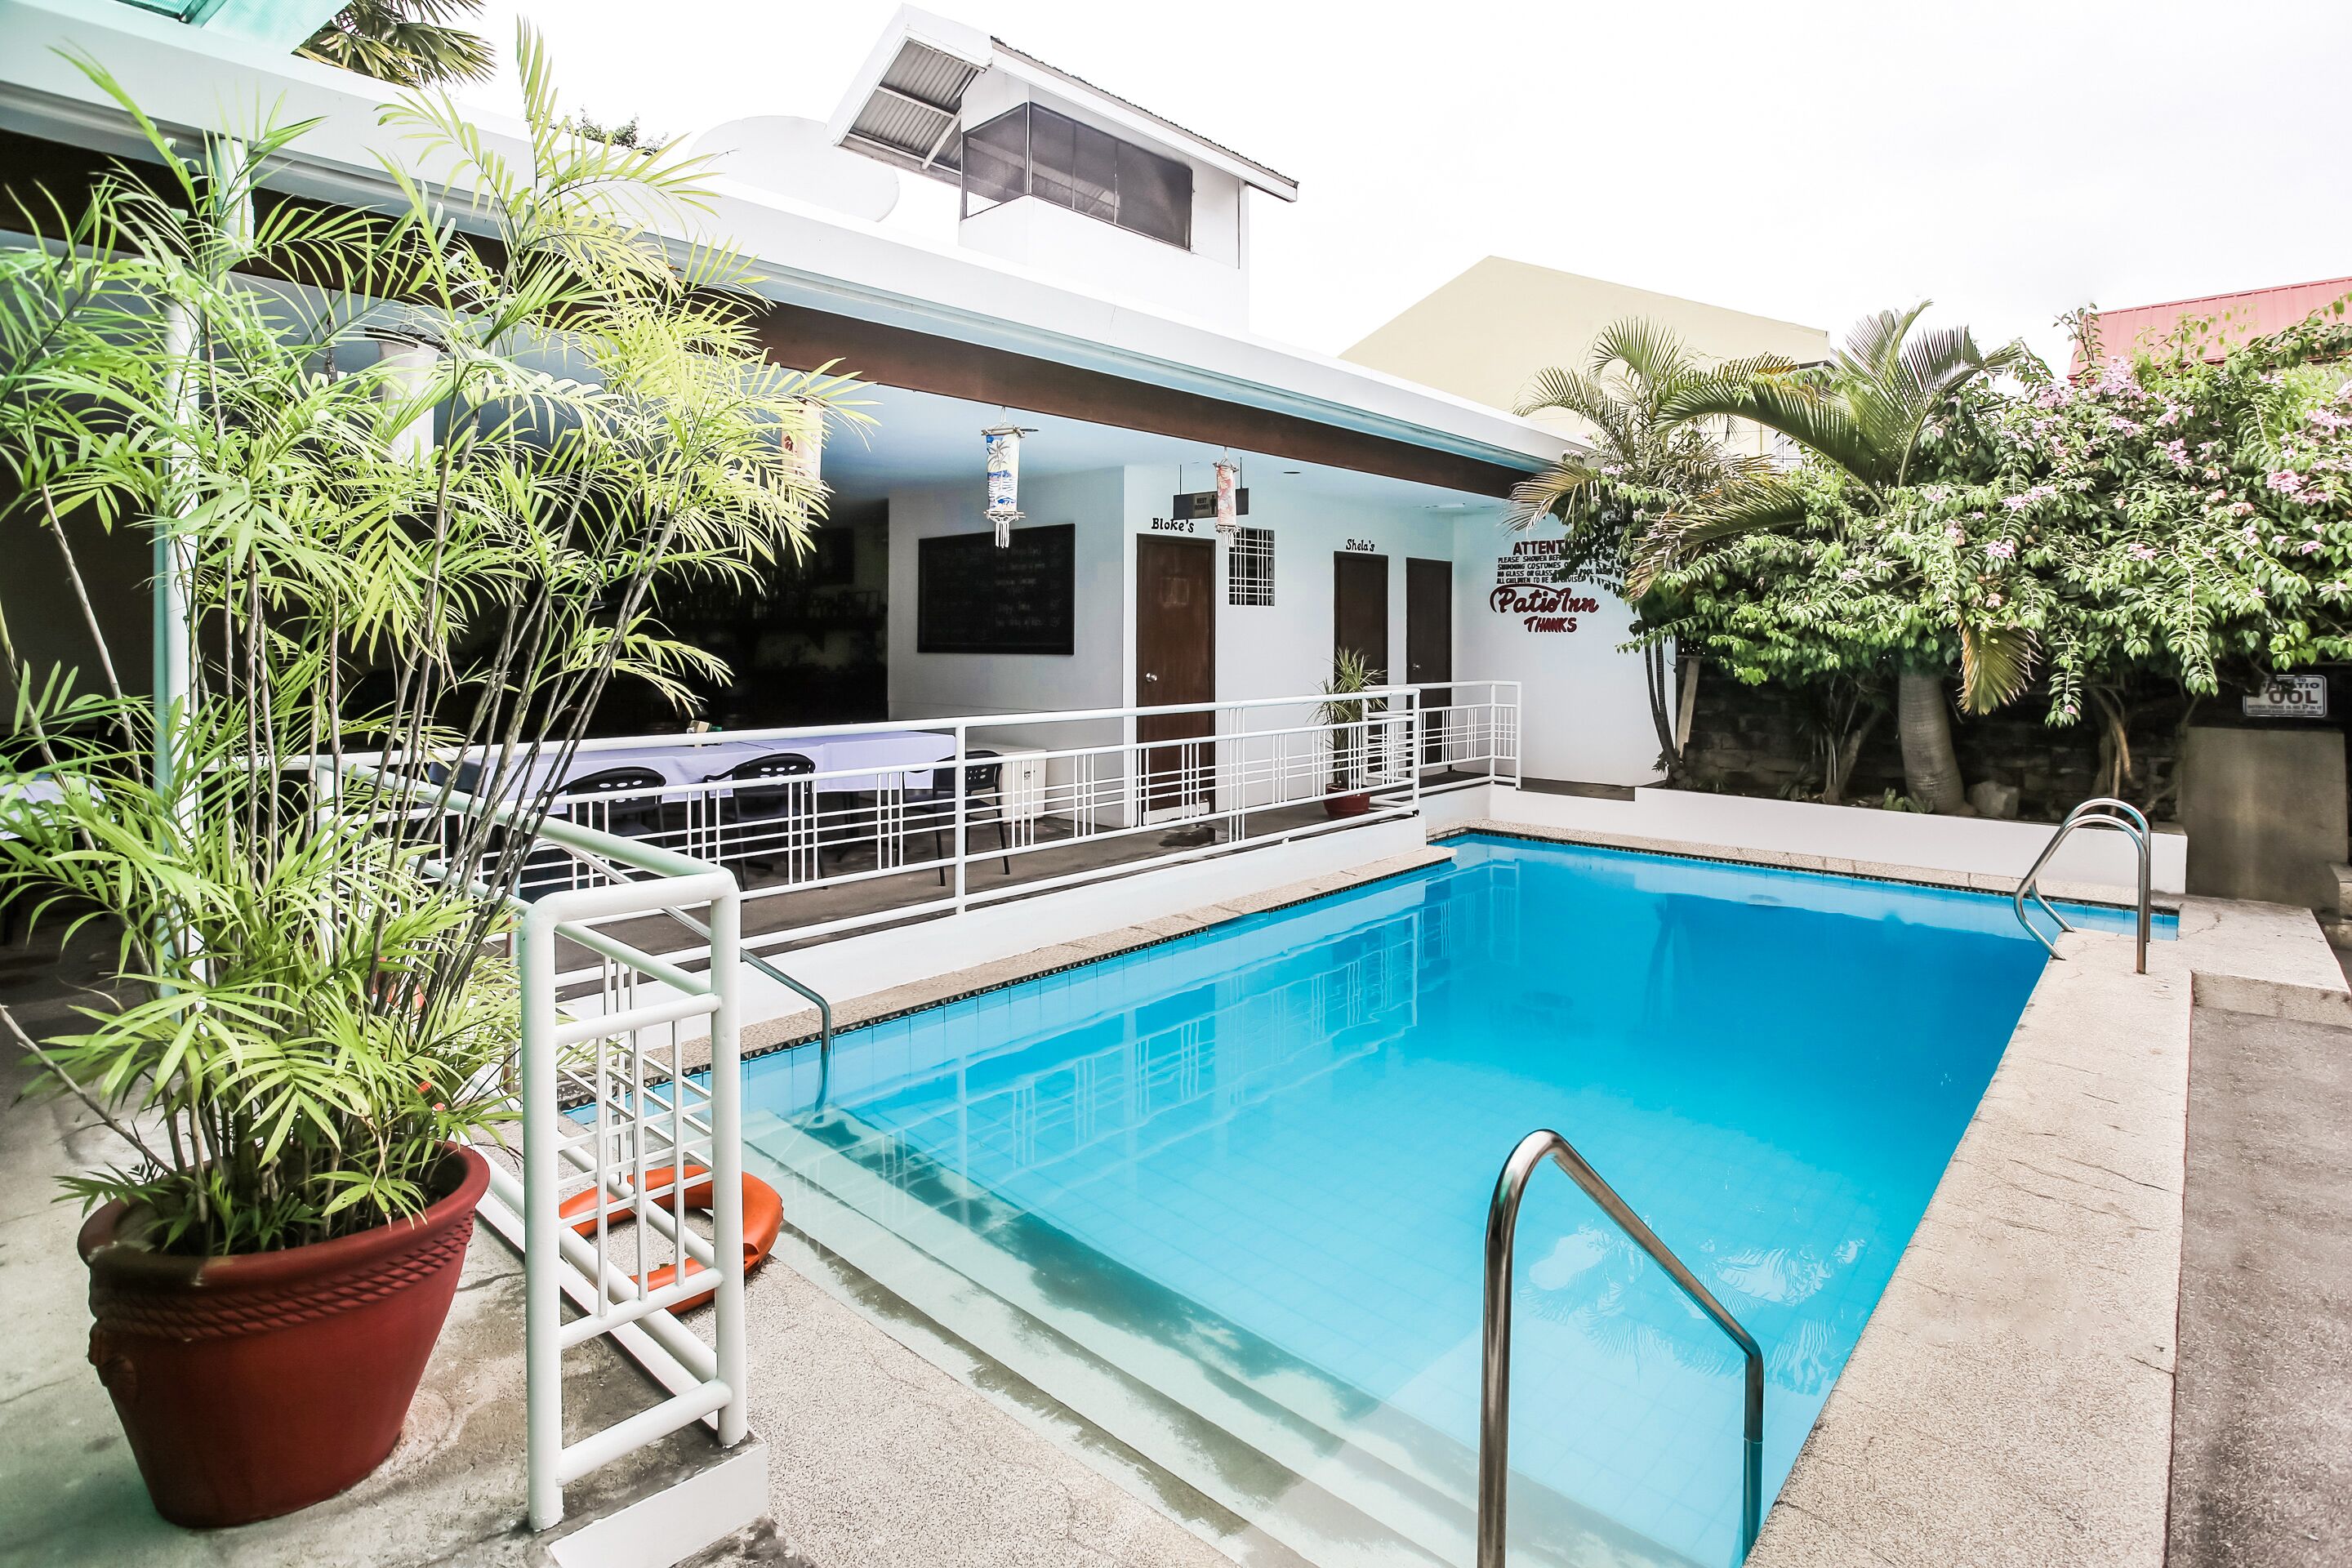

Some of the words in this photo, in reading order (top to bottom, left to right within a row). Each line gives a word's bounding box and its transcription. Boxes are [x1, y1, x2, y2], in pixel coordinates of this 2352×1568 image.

[1152, 518, 1194, 532] Bloke's
[1346, 539, 1374, 551] Shela's
[1513, 540, 1586, 555] ATTENT
[1557, 587, 1599, 613] Inn
[1524, 616, 1577, 633] THANKS
